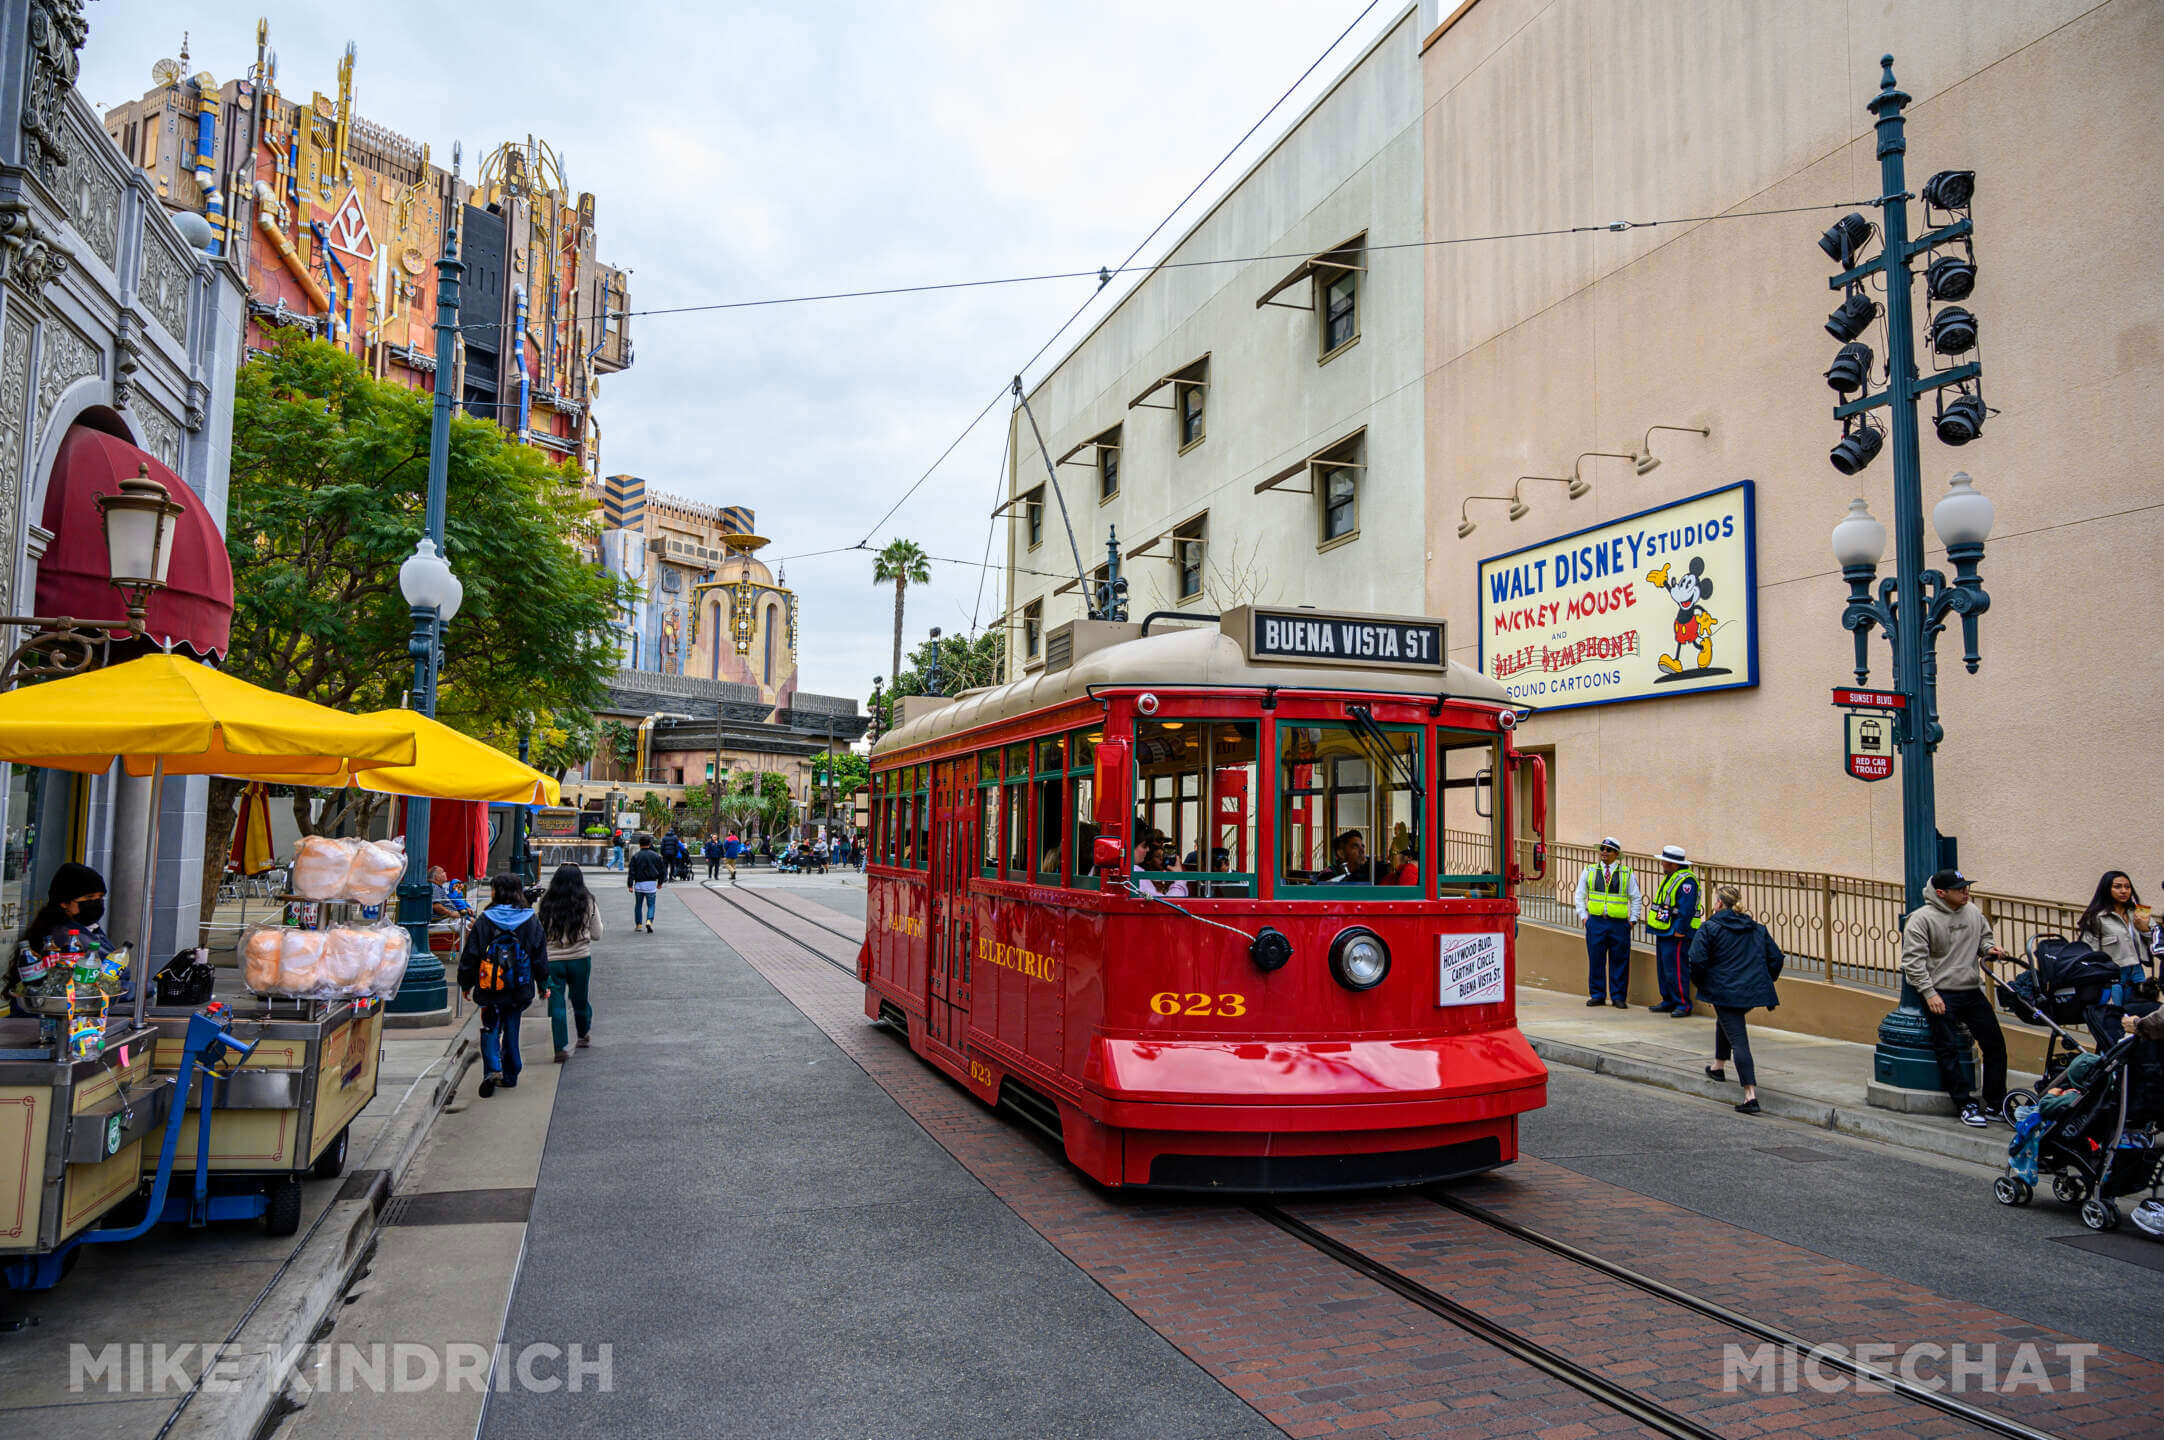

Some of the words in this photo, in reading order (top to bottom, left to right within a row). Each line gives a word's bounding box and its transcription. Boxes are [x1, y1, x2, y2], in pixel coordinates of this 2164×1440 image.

[1490, 559, 1547, 604] WALT
[1555, 530, 1645, 588] DISNEY
[1646, 515, 1734, 557] STUDIOS
[1495, 600, 1560, 635] MICKEY
[1566, 582, 1637, 621] MOUSE
[1265, 619, 1335, 653] BUENA
[1342, 624, 1399, 657] VISTA
[1405, 630, 1430, 659] ST
[1551, 631, 1567, 641] AND
[1506, 681, 1546, 699] SOUND
[1550, 670, 1621, 693] CARTOONS
[1849, 693, 1873, 704] SUNSET
[1876, 695, 1893, 705] BLVD.
[1855, 757, 1870, 766] RED
[1872, 758, 1886, 767] CAR
[1855, 765, 1887, 775] TROLLEY
[888, 911, 924, 938] PACIFIC
[978, 936, 1055, 983] ELECTRIC
[1443, 943, 1477, 969] HOLLYWOOD
[1478, 936, 1492, 952] BLVD.
[1451, 962, 1475, 982] CARTHAY
[1477, 951, 1495, 970] CIRCLE
[1459, 978, 1476, 998] BUENA
[1477, 972, 1492, 988] VISTA
[1150, 992, 1247, 1017] 623
[971, 1060, 992, 1087] 623
